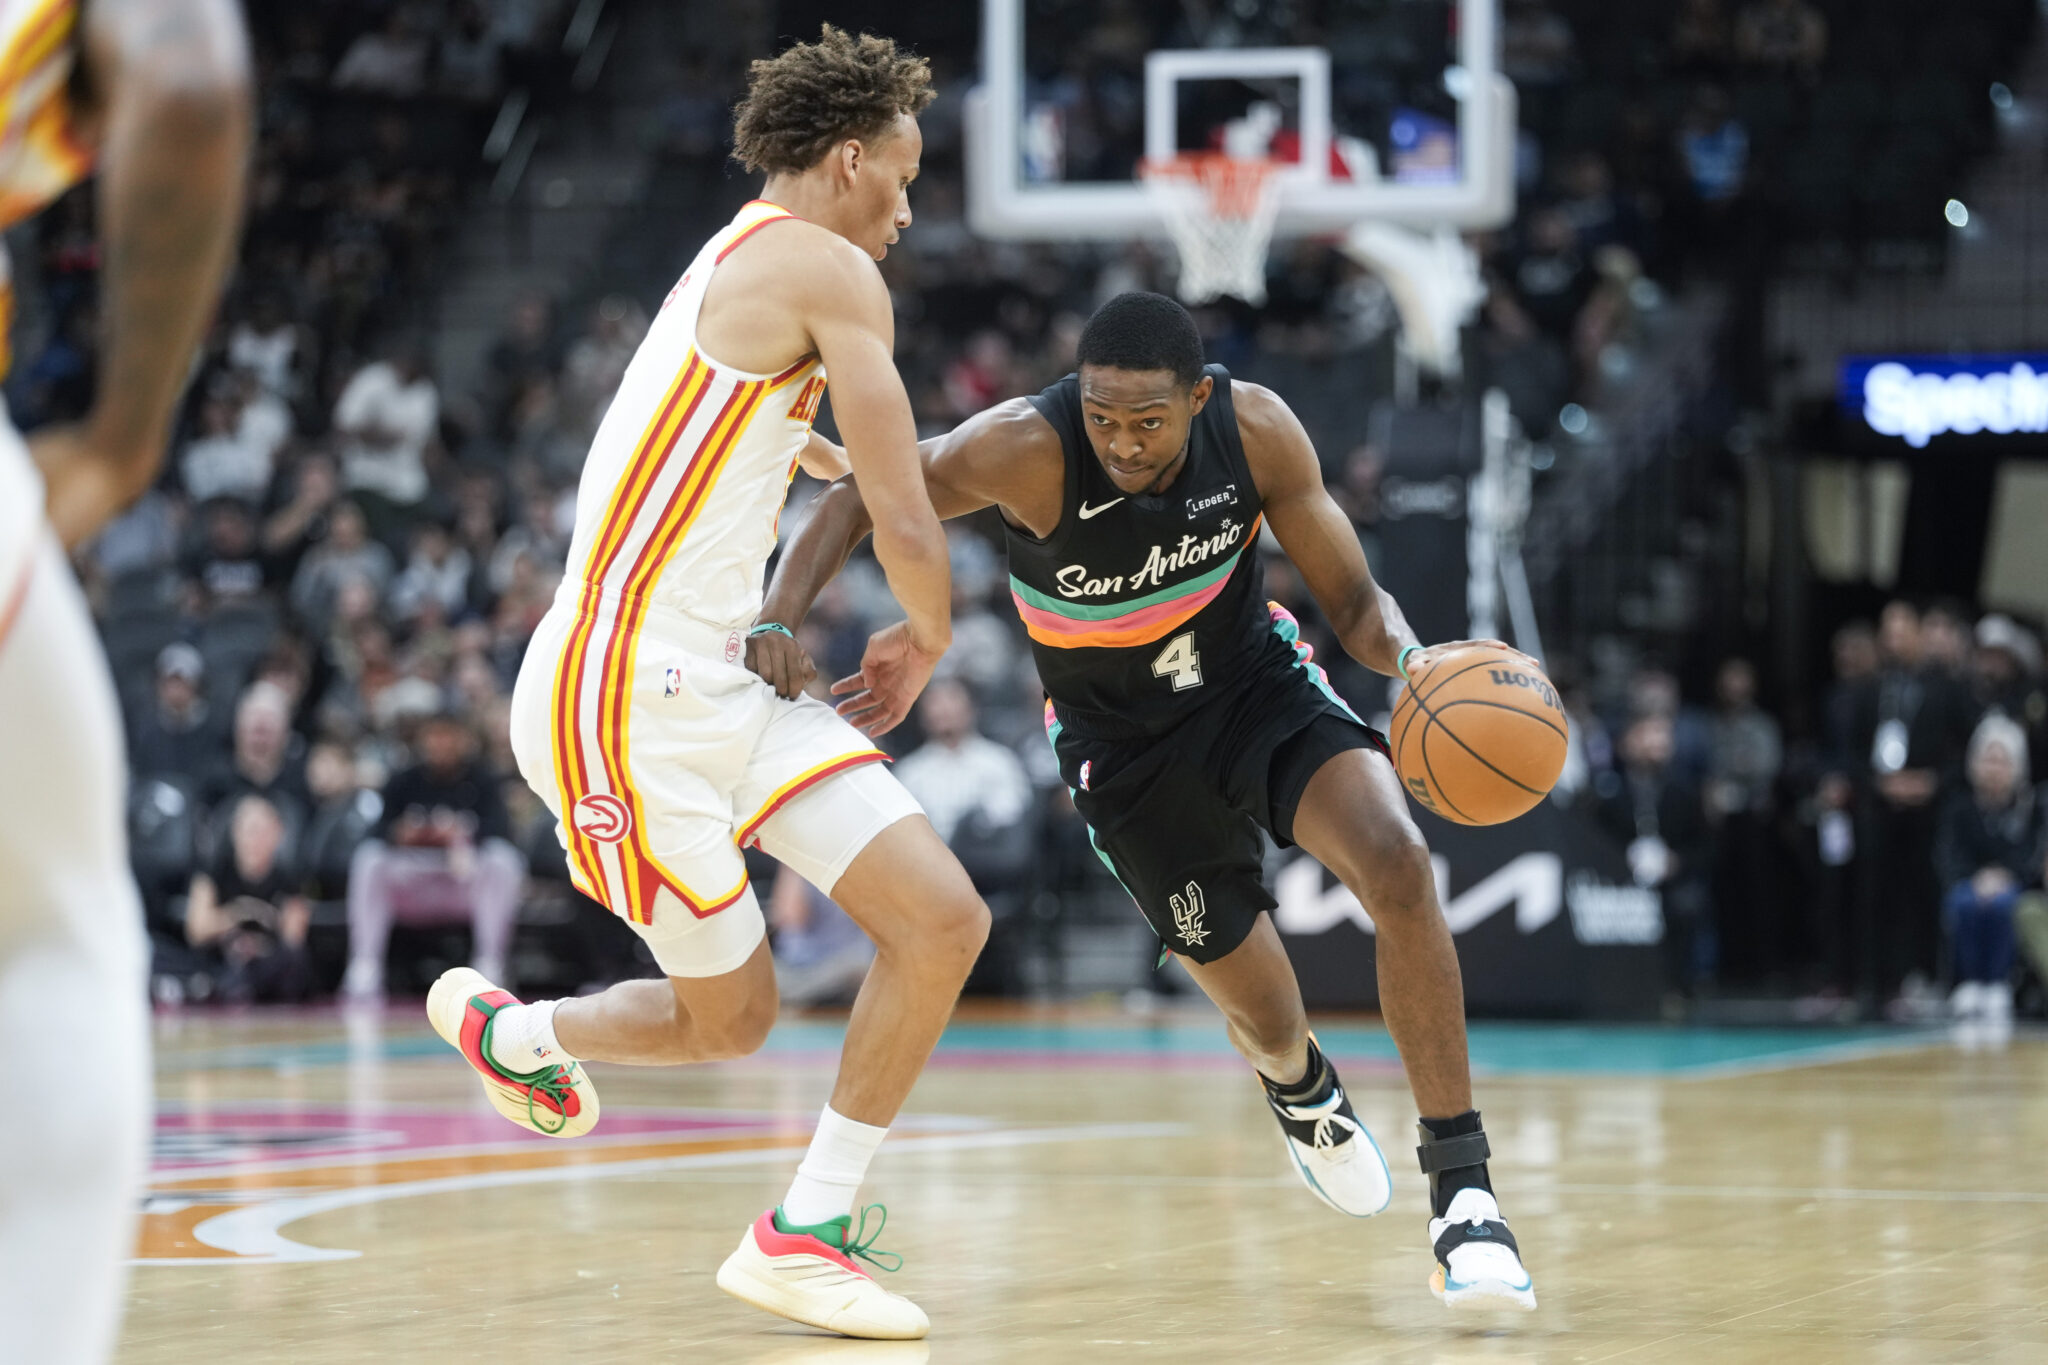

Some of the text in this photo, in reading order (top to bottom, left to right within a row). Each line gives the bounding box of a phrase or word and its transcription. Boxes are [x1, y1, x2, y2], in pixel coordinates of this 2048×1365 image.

[1191, 491, 1231, 512] LEDGER
[1055, 519, 1244, 598] San Antonio
[1151, 631, 1204, 692] 4
